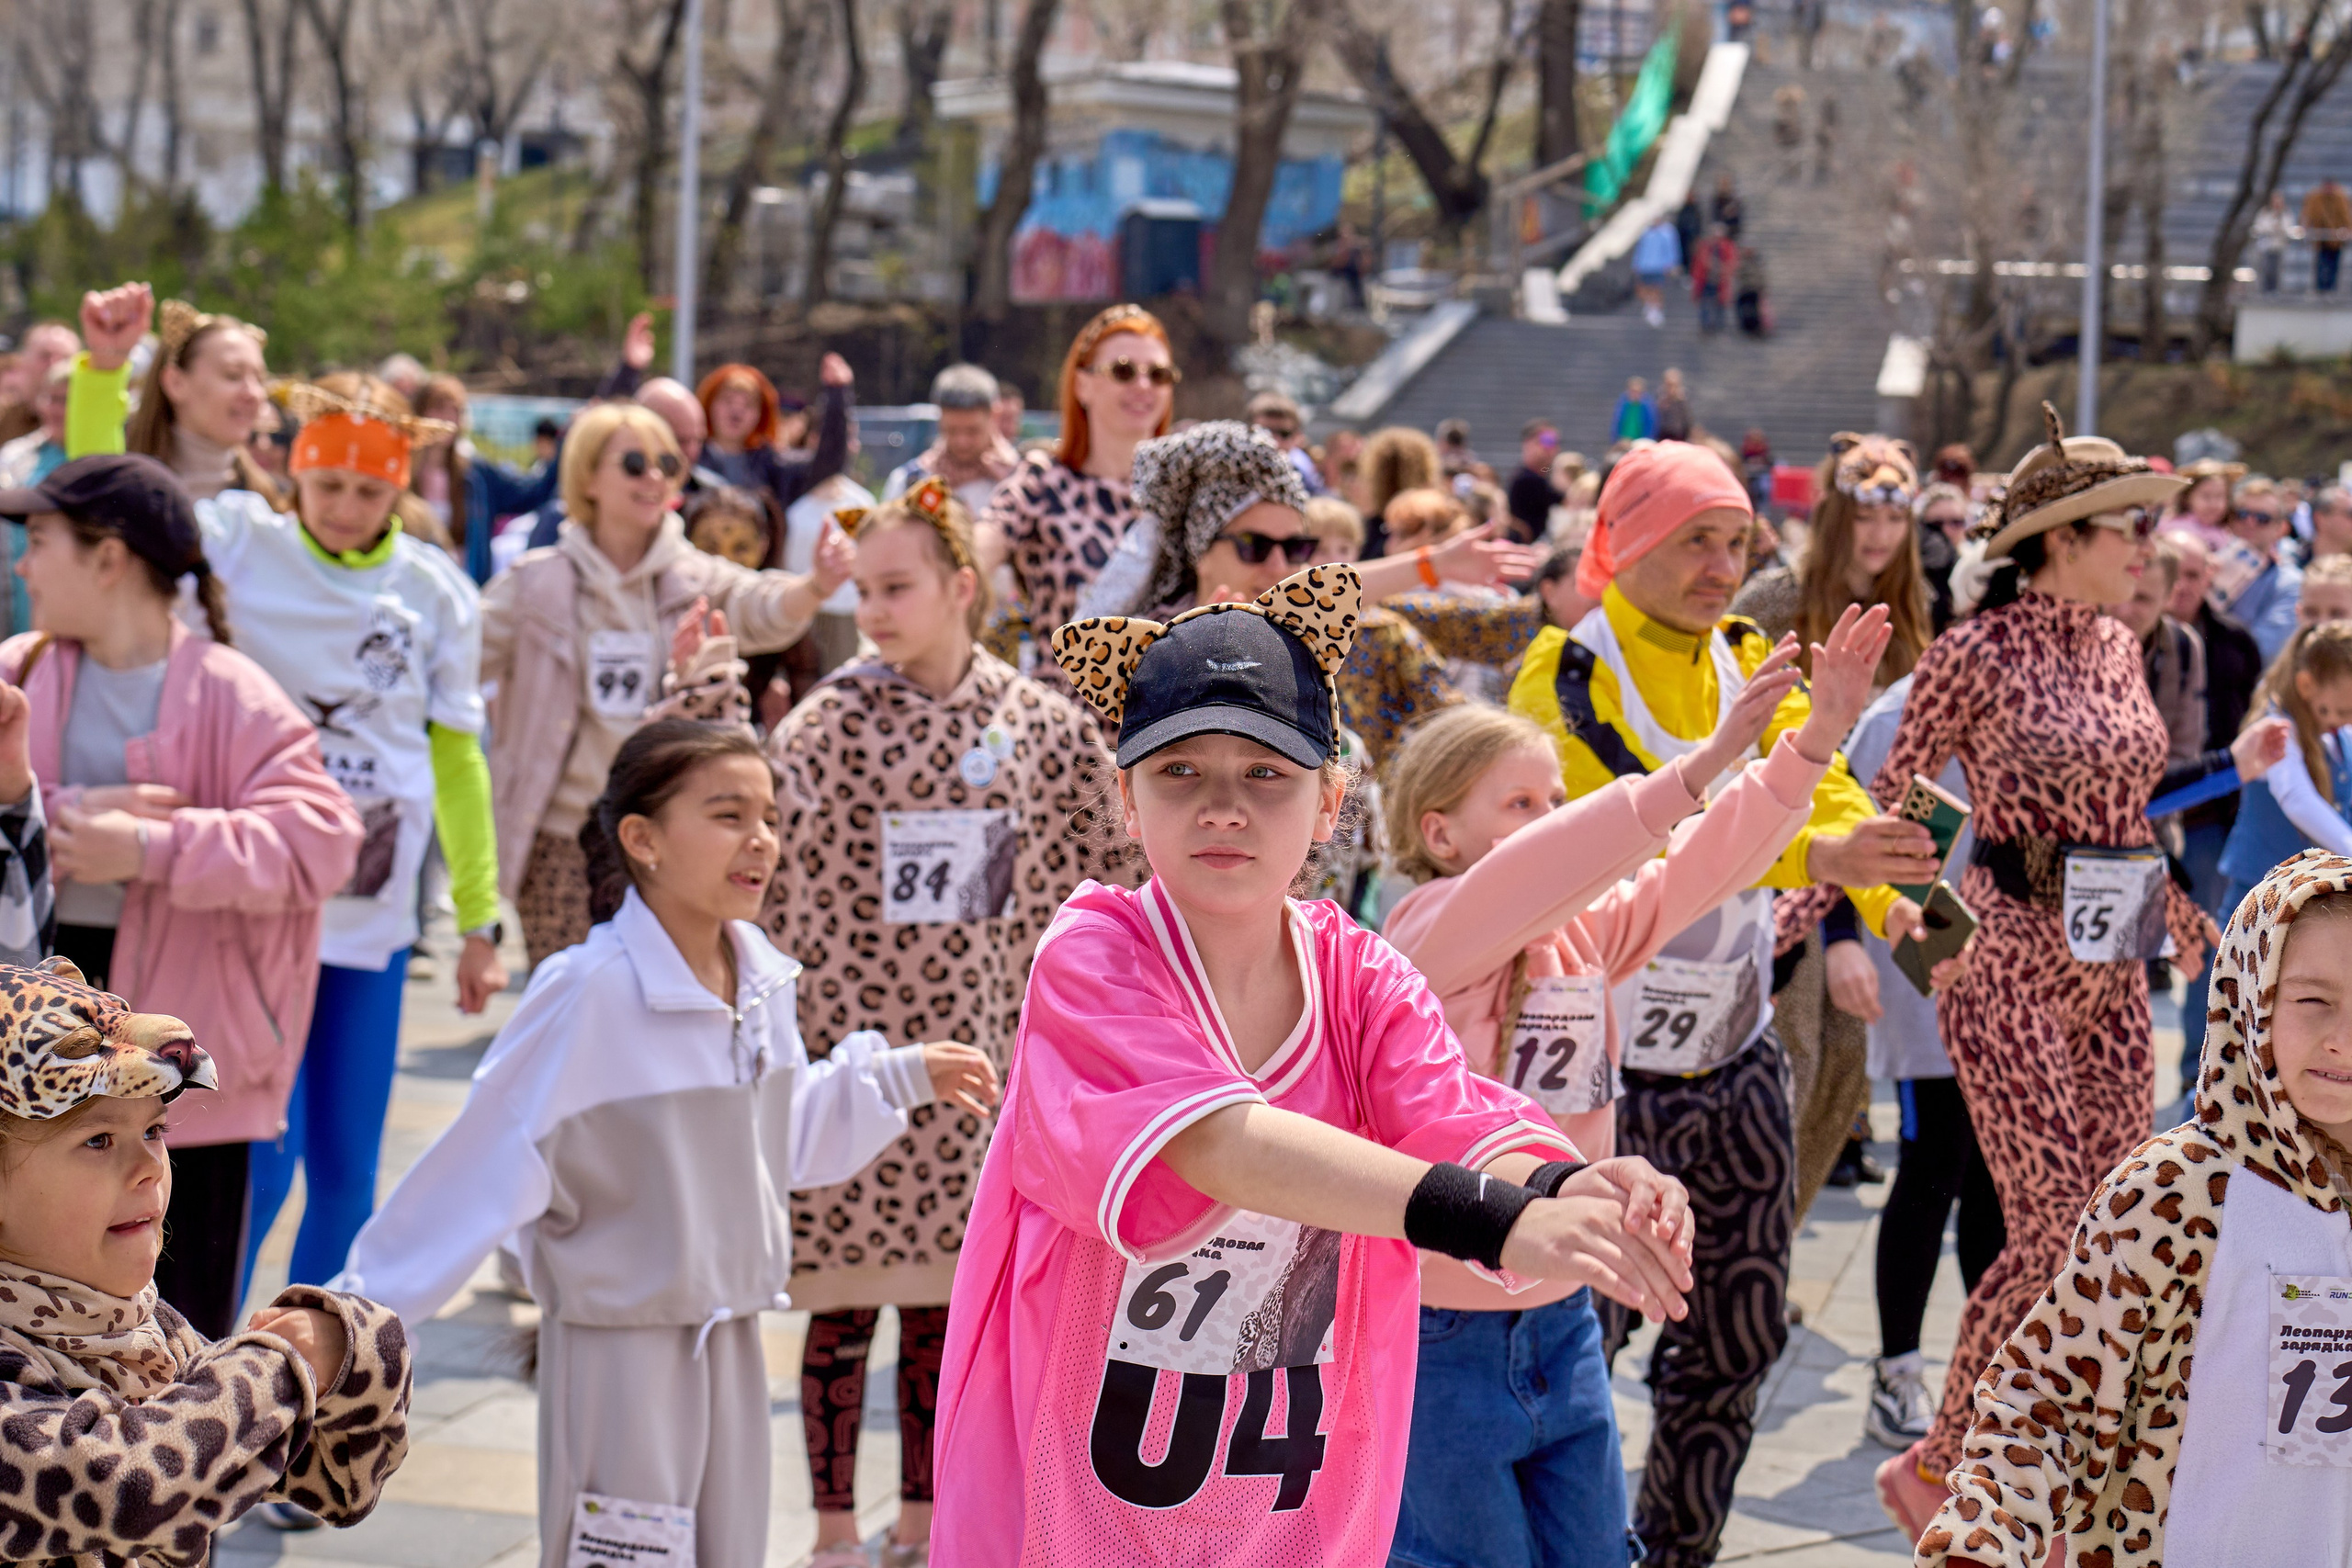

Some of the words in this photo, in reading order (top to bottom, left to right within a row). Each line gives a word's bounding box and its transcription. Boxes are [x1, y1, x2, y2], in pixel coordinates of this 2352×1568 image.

[596, 671, 640, 699] 99
[892, 861, 950, 902] 84
[2070, 905, 2113, 942] 65
[1635, 1008, 1697, 1050] 29
[1514, 1037, 1577, 1090] 12
[1127, 1262, 1231, 1342] 61
[2280, 1341, 2352, 1354] зарядка
[2278, 1359, 2352, 1434] 13
